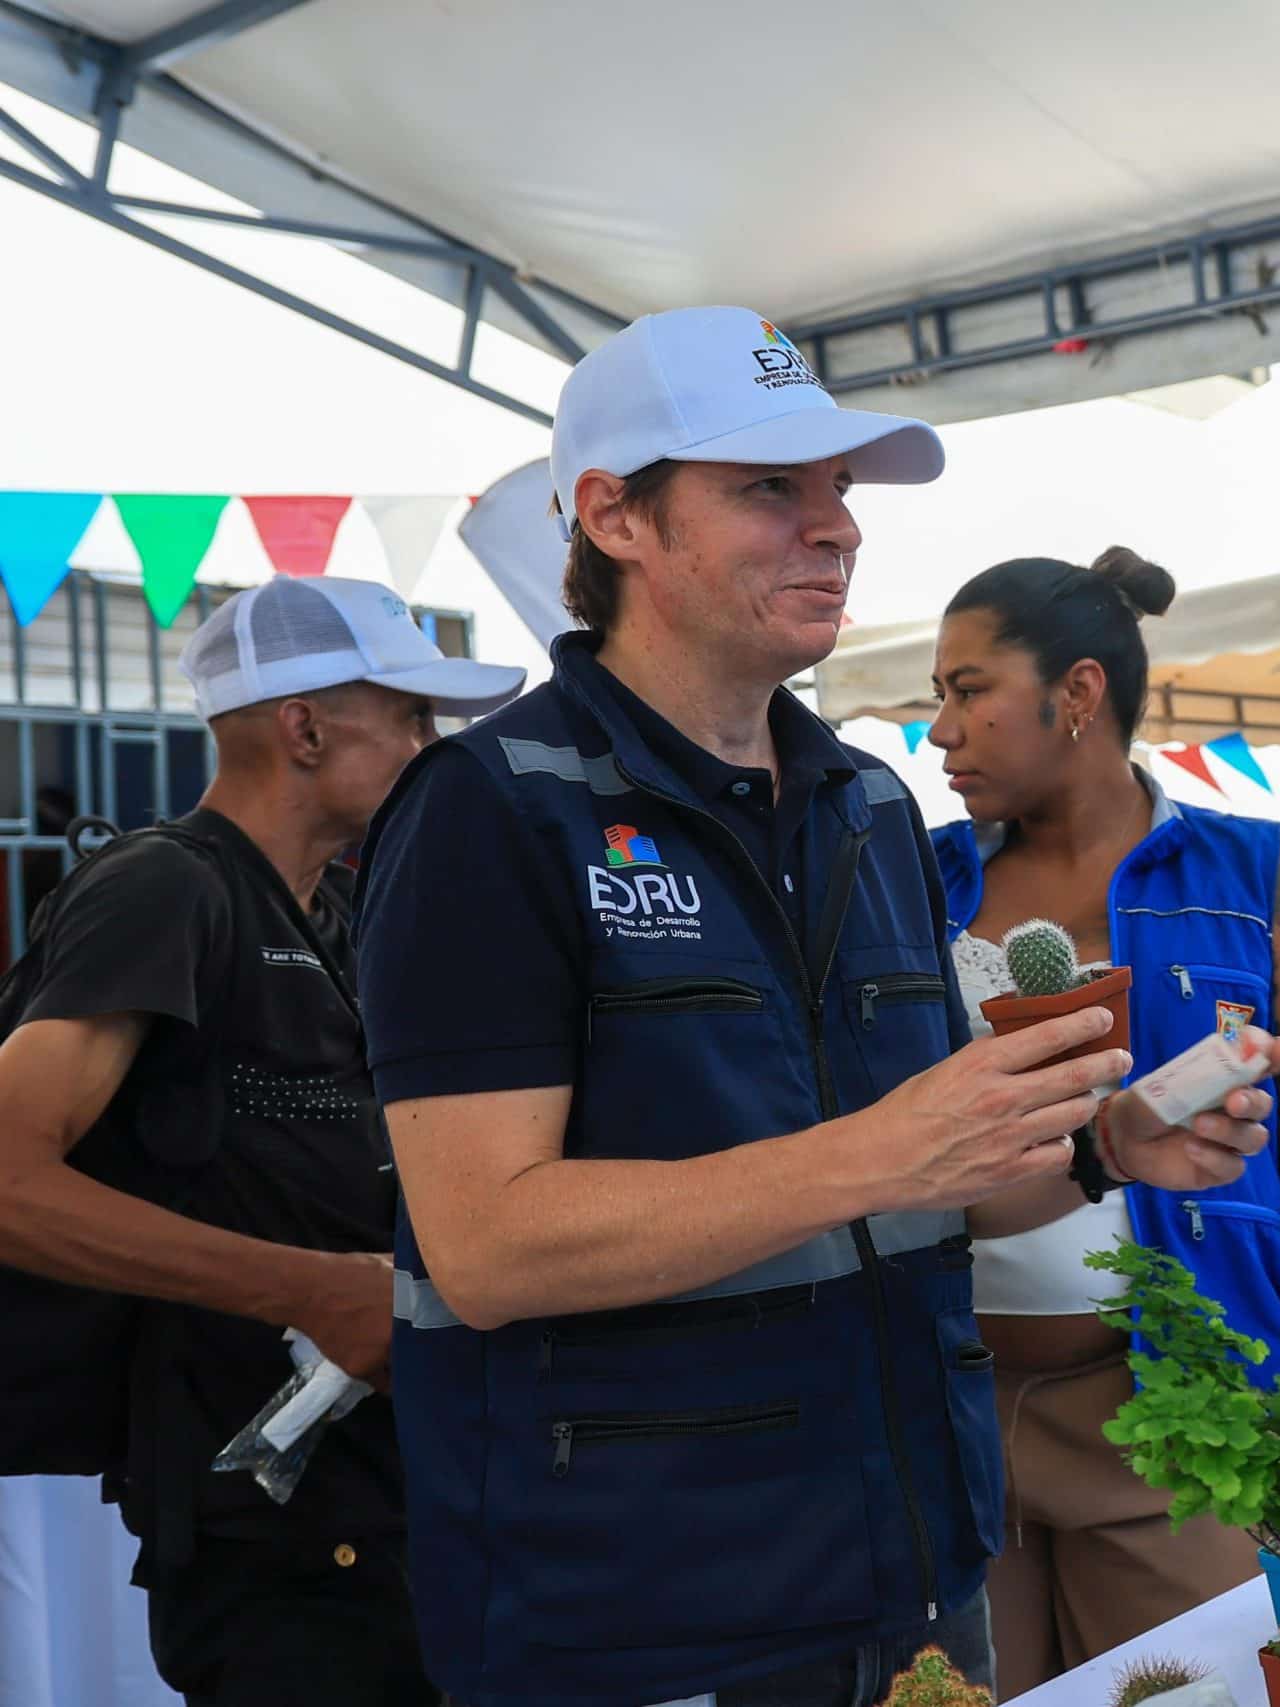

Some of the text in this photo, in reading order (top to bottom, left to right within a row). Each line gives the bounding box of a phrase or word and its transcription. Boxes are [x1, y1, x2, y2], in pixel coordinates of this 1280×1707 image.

[587, 865, 701, 914] EDRU
[600, 912, 701, 927] Empresa de Desarrollo
[605, 926, 702, 940] y Renovación Urbana
